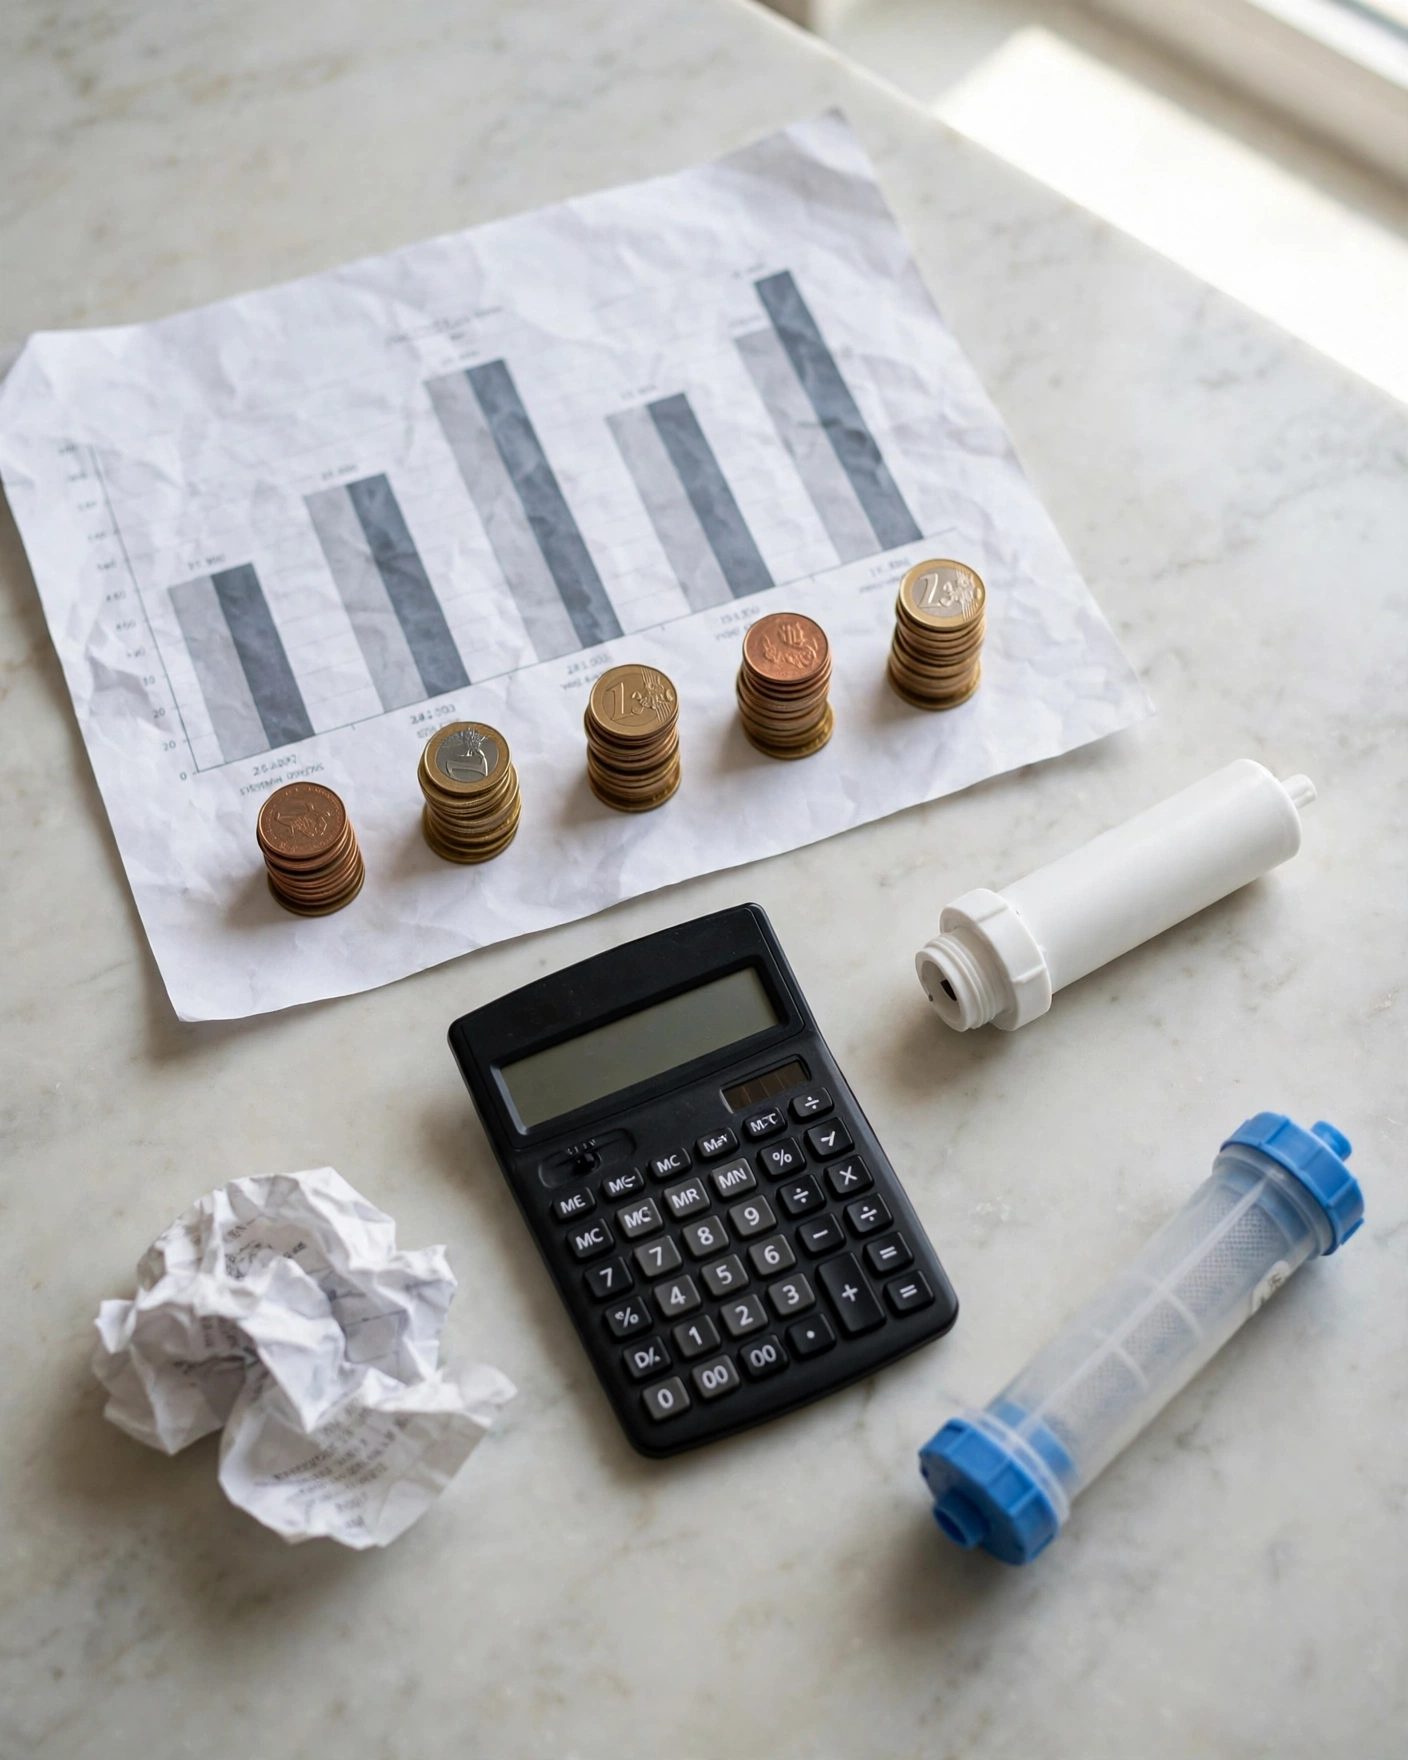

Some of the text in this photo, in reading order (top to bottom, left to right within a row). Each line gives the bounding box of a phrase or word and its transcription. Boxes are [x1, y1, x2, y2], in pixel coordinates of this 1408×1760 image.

[656, 1154, 681, 1173] MC
[772, 1149, 793, 1167] %
[718, 1167, 748, 1189] MN
[560, 1194, 586, 1214] ME
[671, 1188, 700, 1209] MR
[744, 1206, 760, 1226] 9
[575, 1228, 604, 1251] MC
[697, 1226, 714, 1245] 8
[648, 1246, 662, 1267] 7
[763, 1245, 780, 1265] 6
[599, 1267, 613, 1288] 7
[715, 1264, 733, 1285] 5
[670, 1285, 687, 1305] 4
[782, 1284, 800, 1305] 3
[734, 1305, 754, 1326] 2
[688, 1325, 703, 1346] 1
[750, 1344, 777, 1368] 00
[702, 1364, 729, 1390] 00
[657, 1388, 674, 1409] 0
